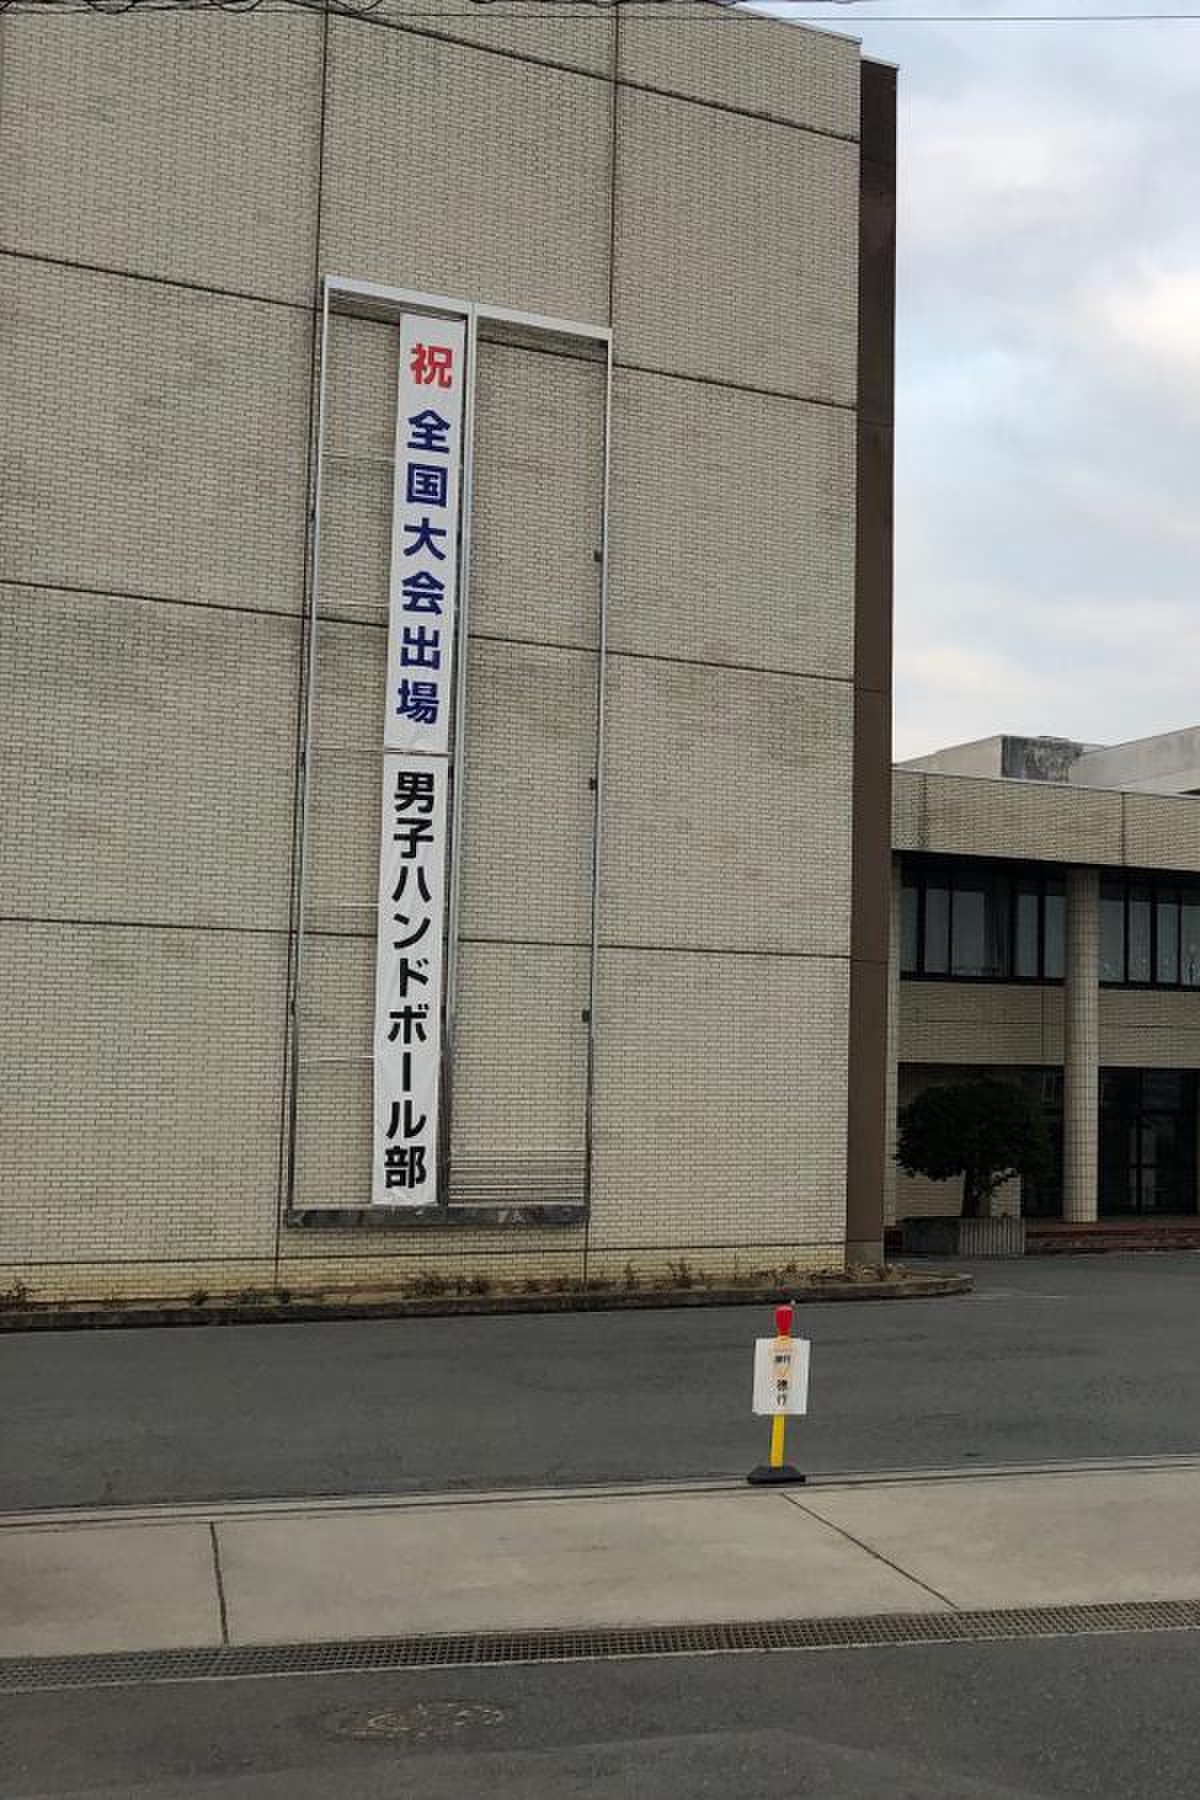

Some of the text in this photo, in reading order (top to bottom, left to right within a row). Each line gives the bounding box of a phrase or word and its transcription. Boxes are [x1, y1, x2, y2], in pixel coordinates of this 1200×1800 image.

[396, 342, 454, 725] 祝 全国大会出場
[383, 770, 436, 1190] 男子ハンドボール部
